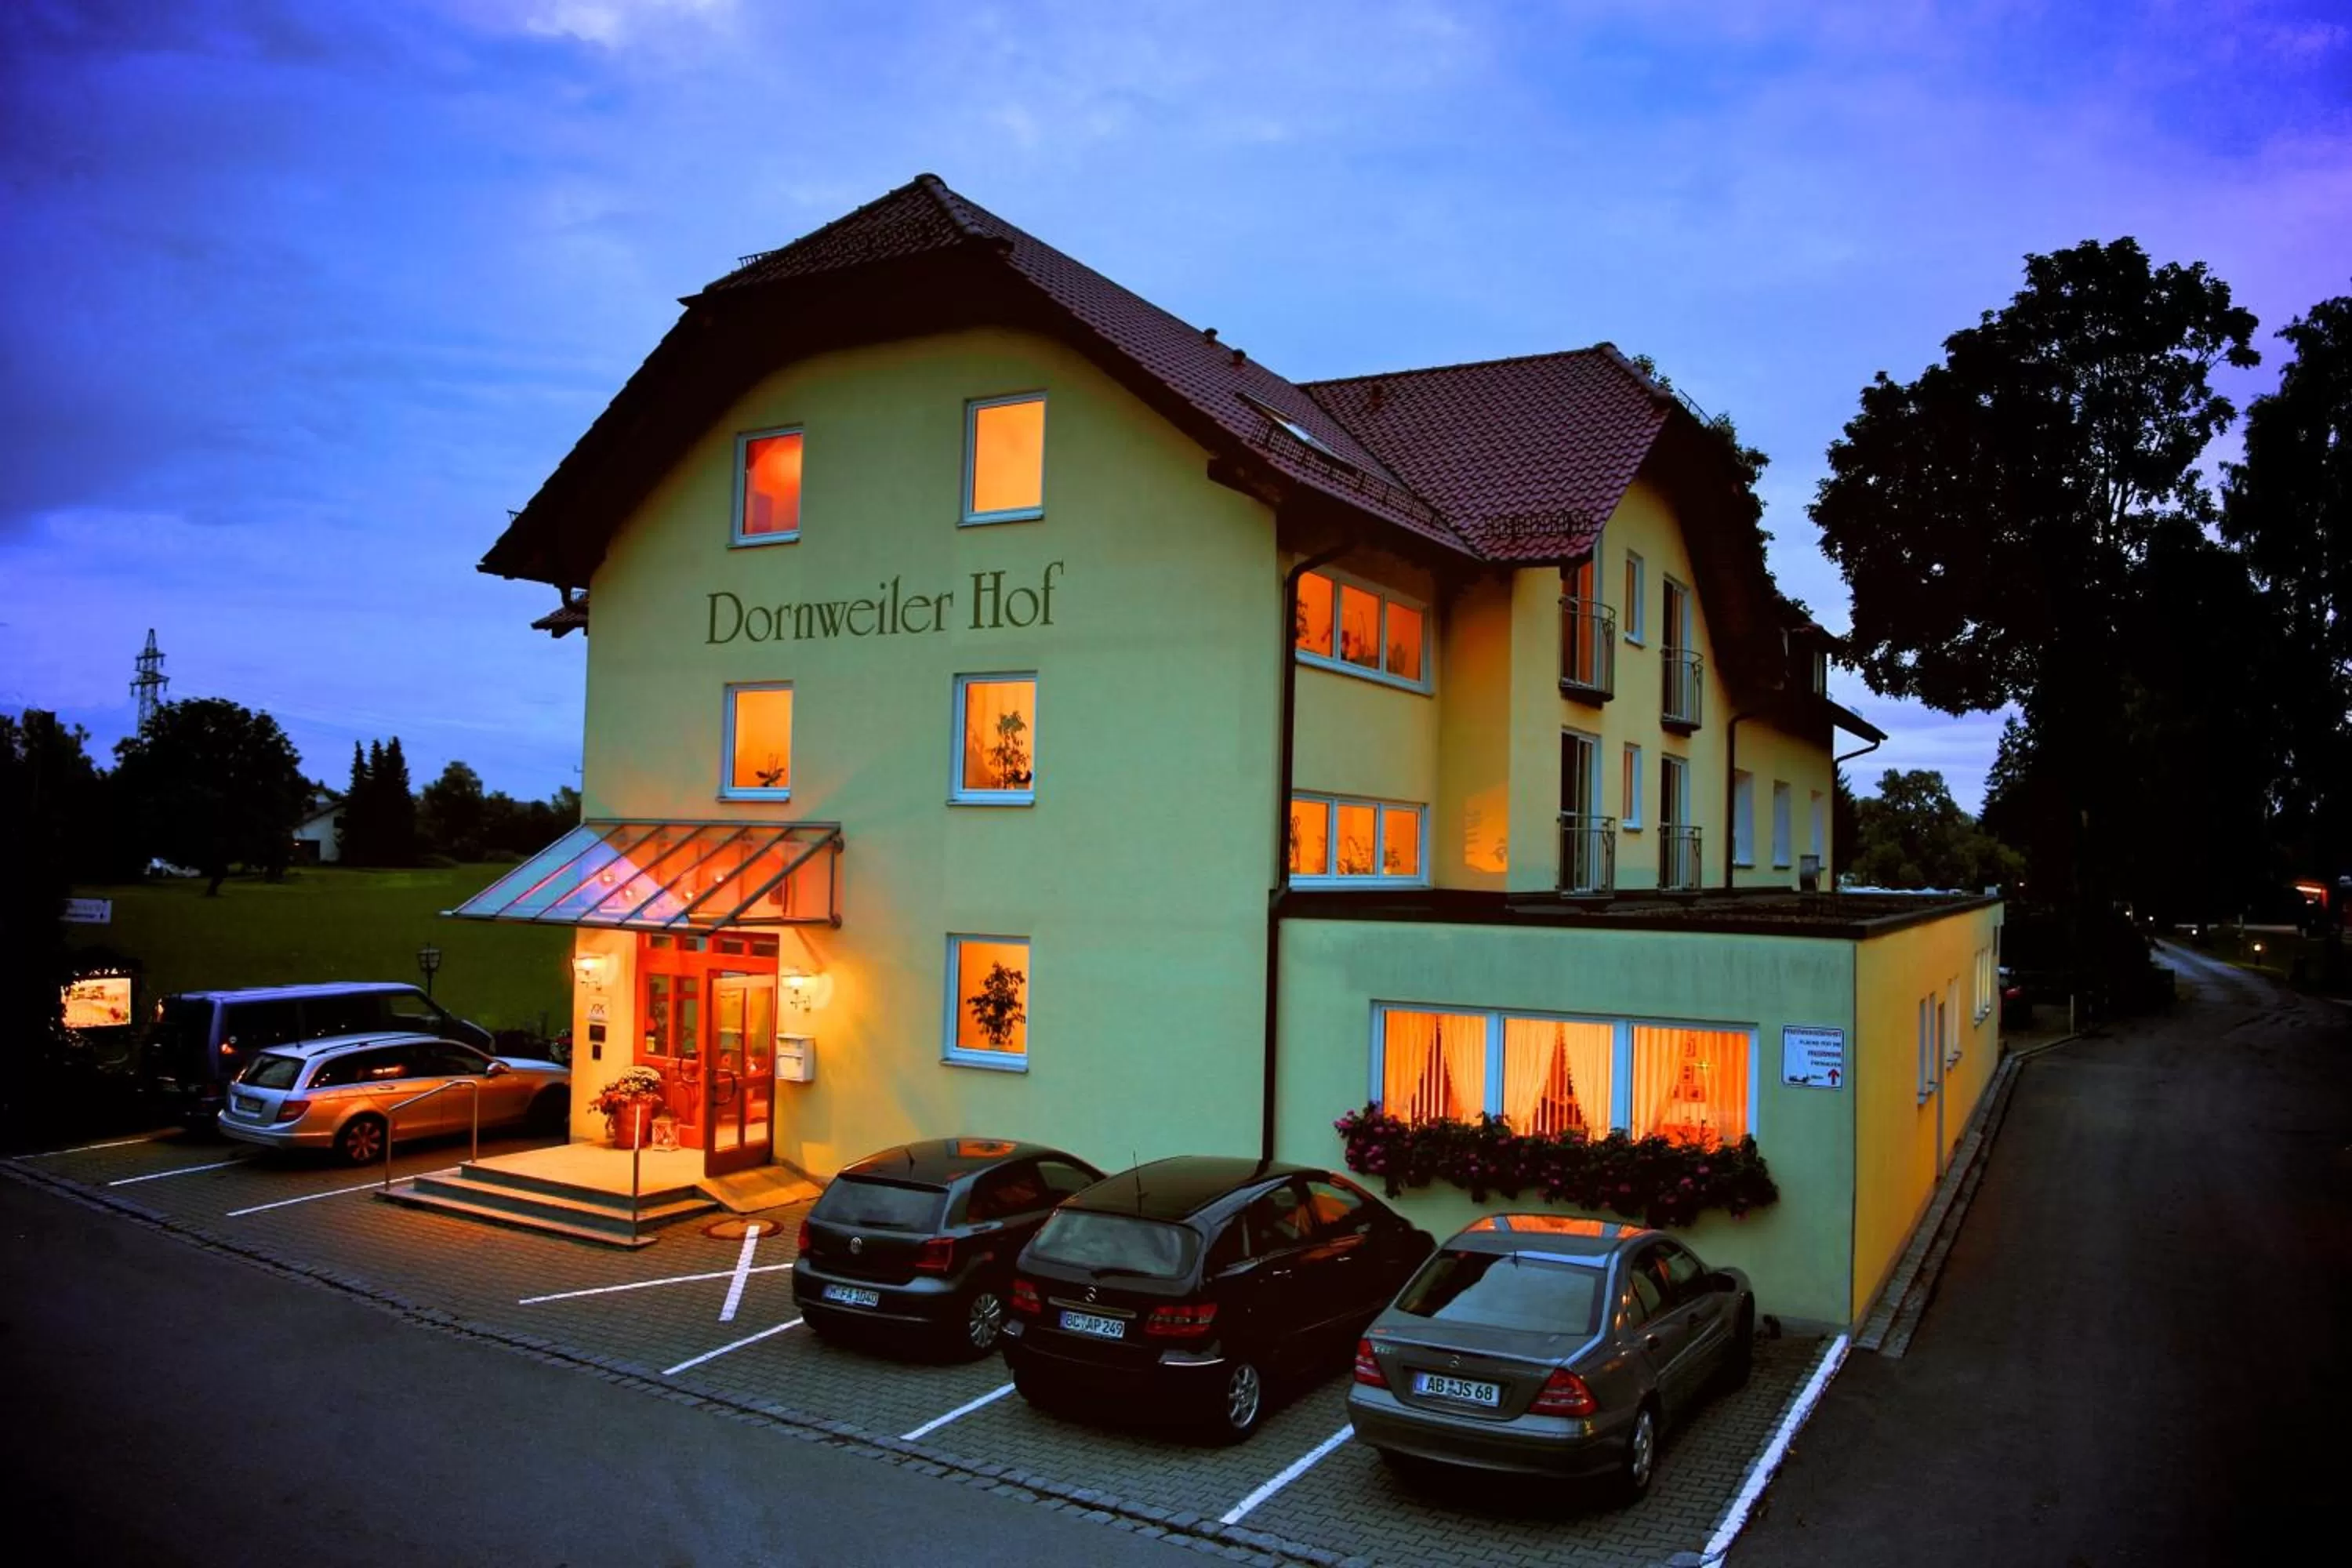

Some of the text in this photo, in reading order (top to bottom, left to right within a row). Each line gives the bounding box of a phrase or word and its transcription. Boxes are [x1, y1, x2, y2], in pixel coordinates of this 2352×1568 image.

[705, 560, 1065, 644] Dornweiler Hof
[1086, 1318, 1101, 1331] AP
[1102, 1320, 1123, 1334] 249
[1426, 1376, 1493, 1400] AB JS 68
